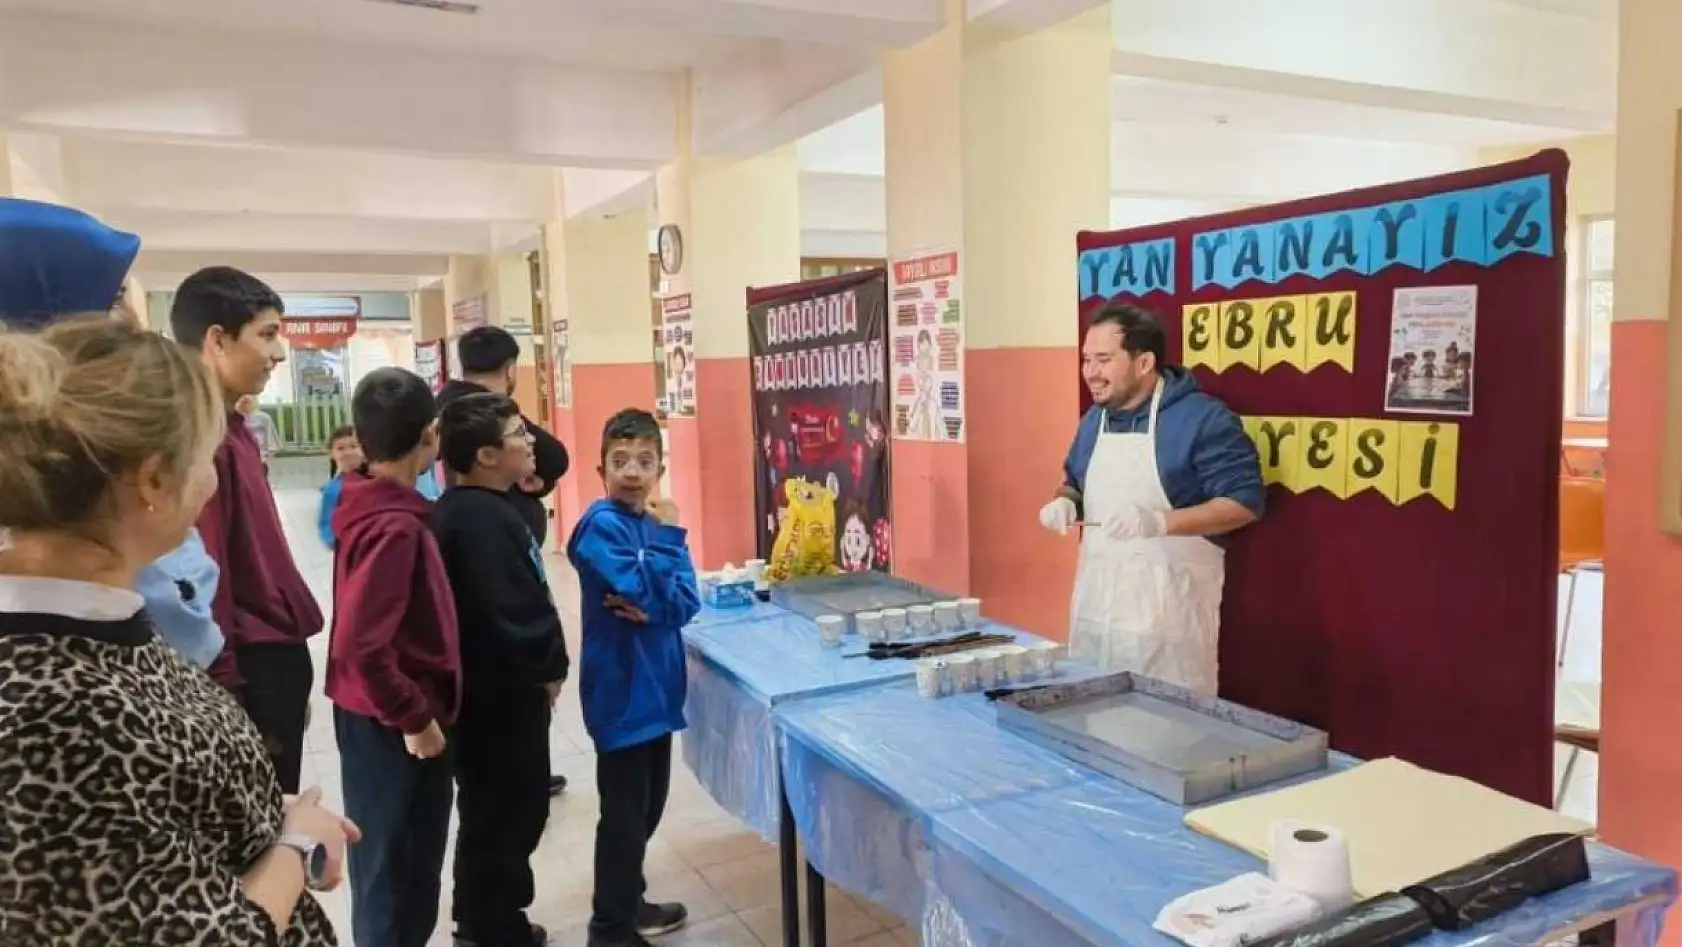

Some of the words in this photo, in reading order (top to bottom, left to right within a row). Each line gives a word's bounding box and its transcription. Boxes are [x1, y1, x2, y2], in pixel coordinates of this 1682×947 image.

[1081, 243, 1171, 294] YAN
[1196, 187, 1541, 281] YANAYIZ
[1188, 295, 1352, 351] EBRU
[1260, 420, 1440, 489] YESİ
